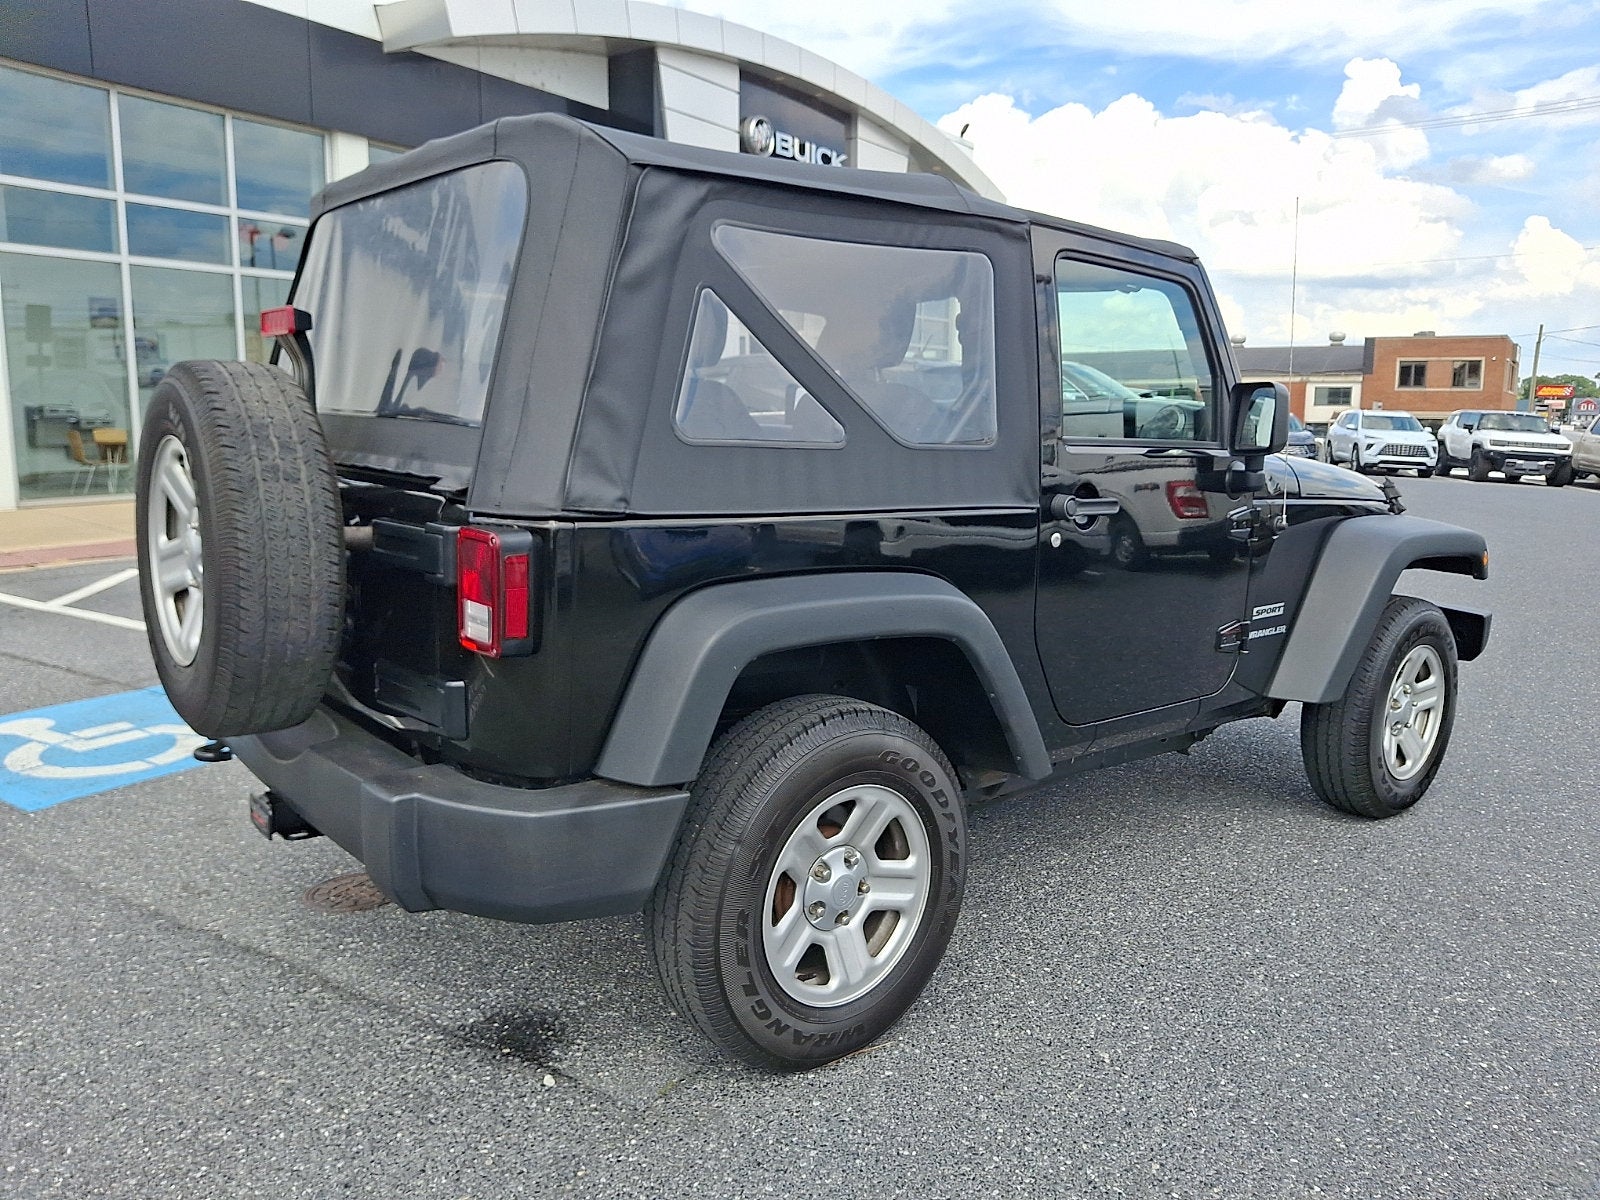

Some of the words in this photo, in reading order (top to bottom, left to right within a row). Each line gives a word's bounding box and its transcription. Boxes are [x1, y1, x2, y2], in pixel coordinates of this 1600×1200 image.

[775, 131, 848, 167] BUICK
[1254, 606, 1283, 616] SPORT
[1249, 625, 1286, 639] WRANGLER
[734, 909, 867, 1047] WRANGLER
